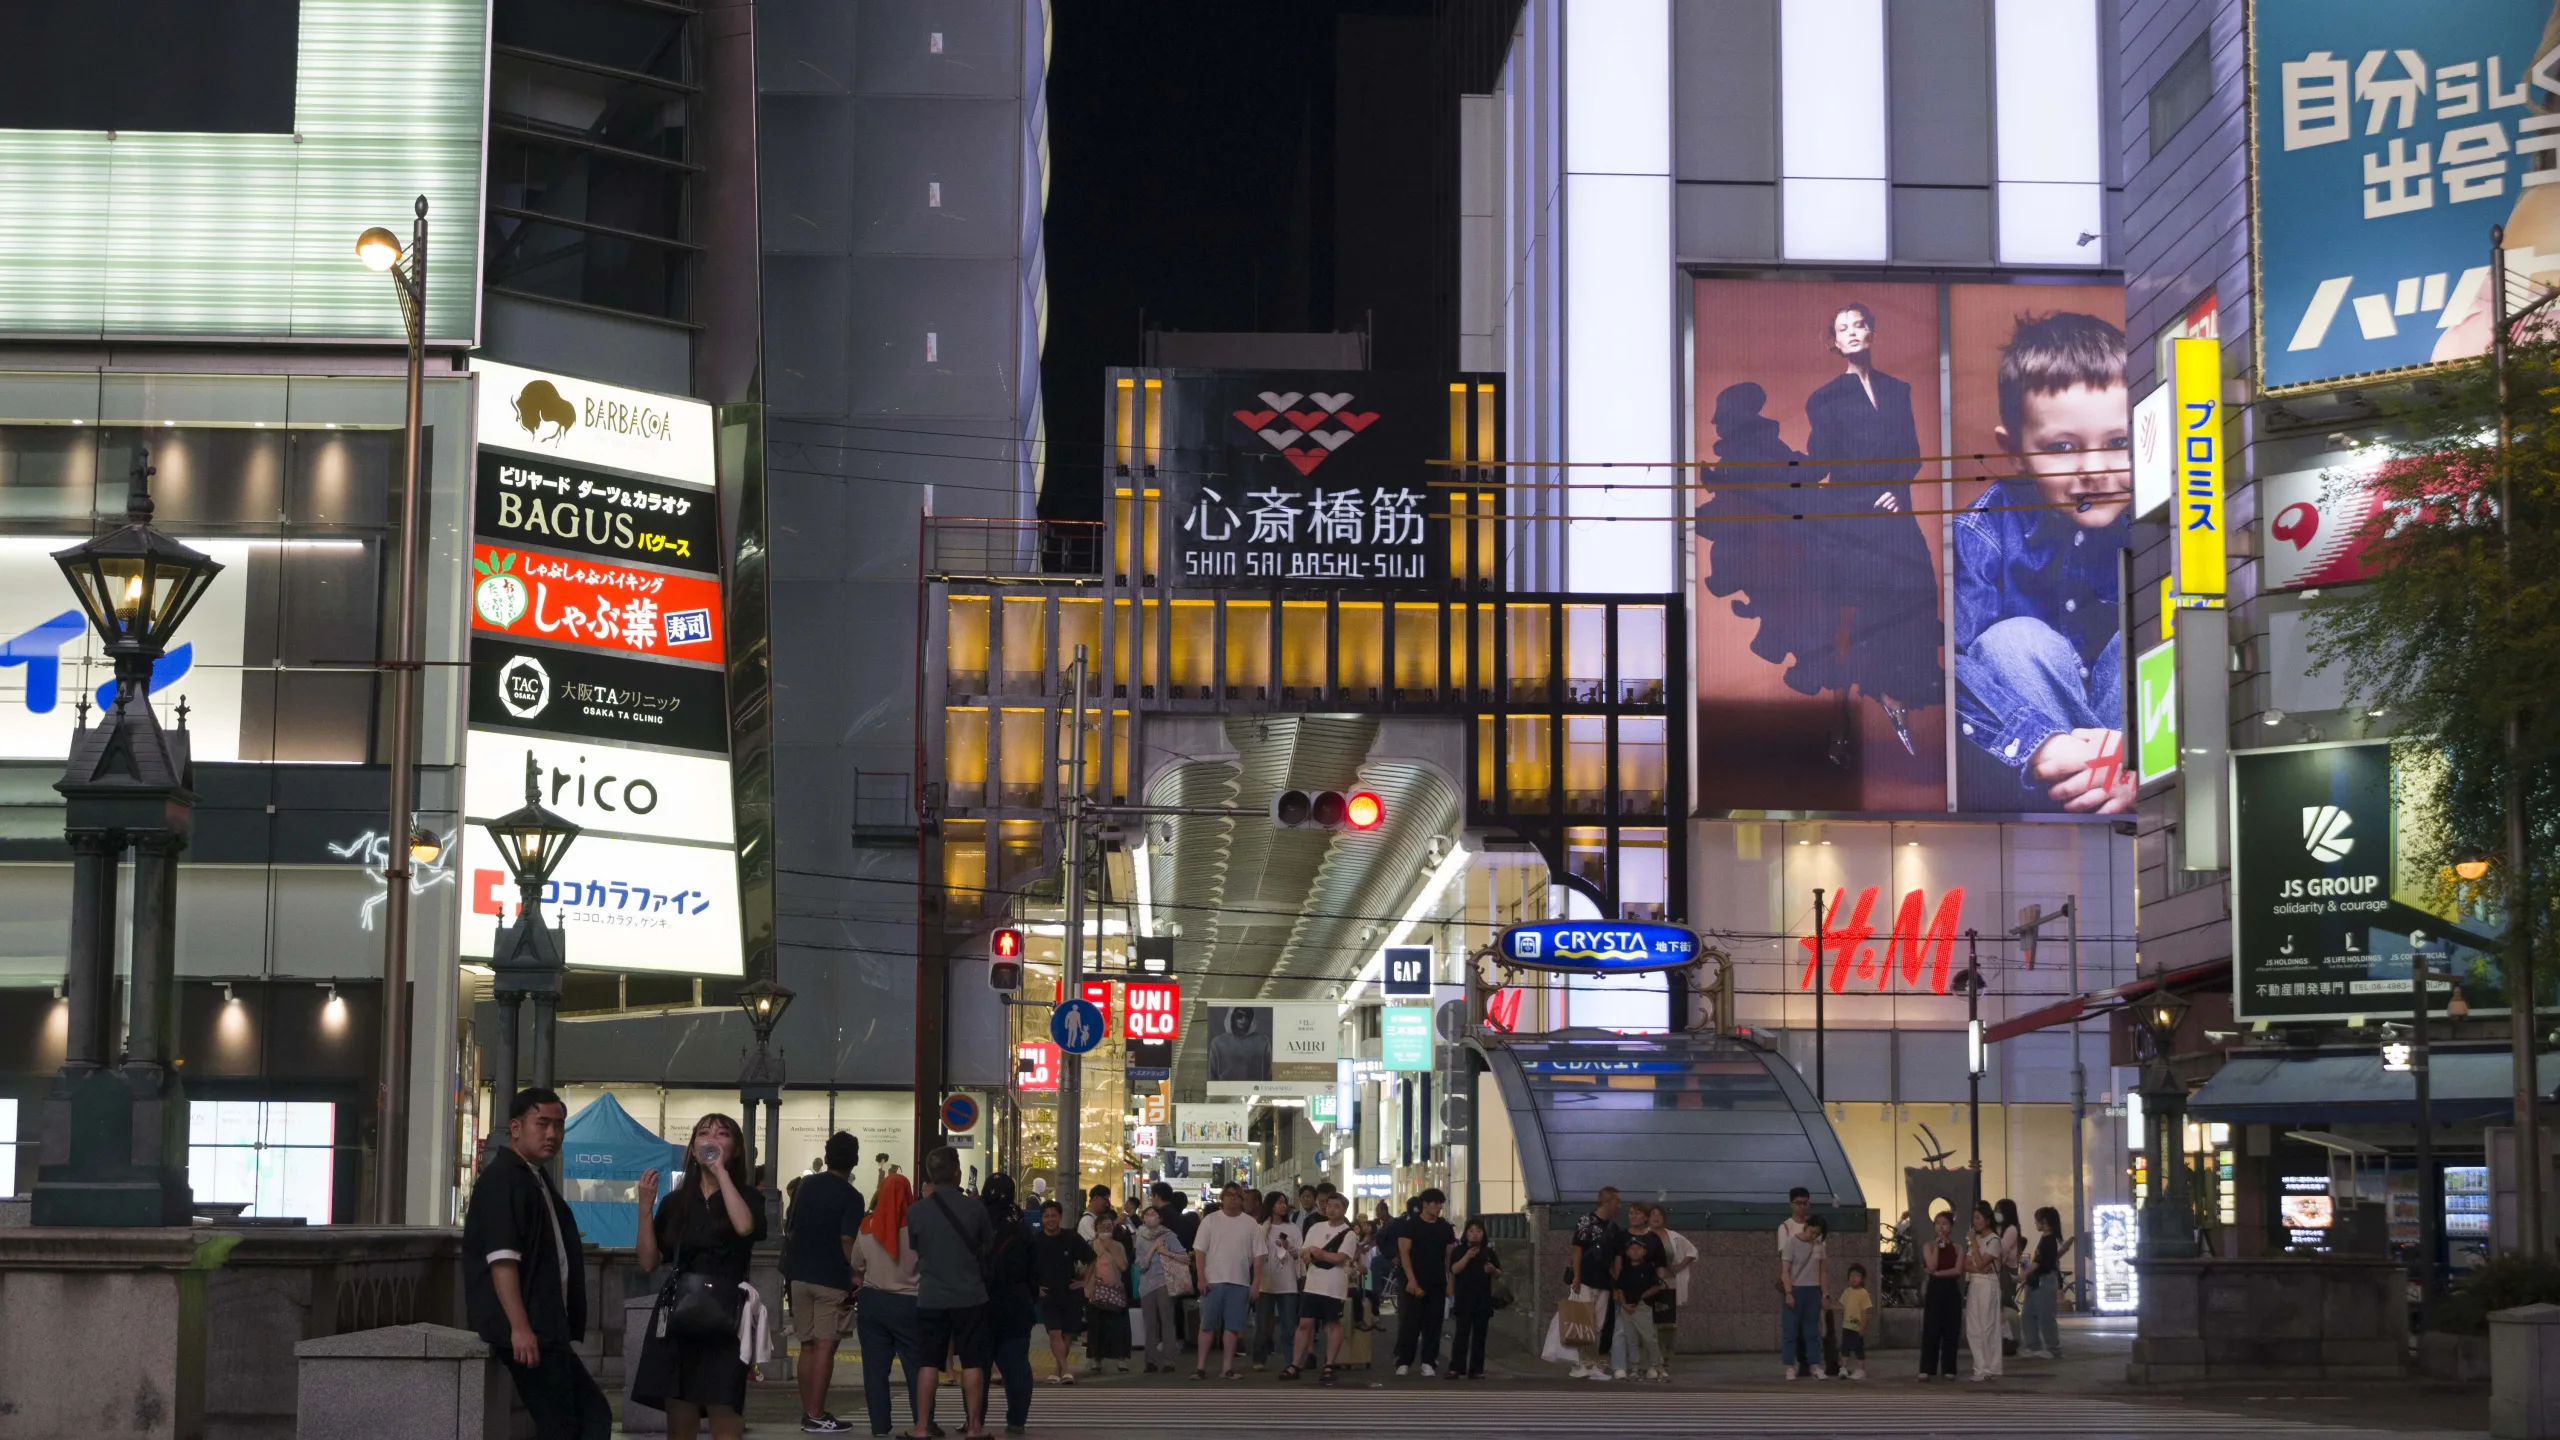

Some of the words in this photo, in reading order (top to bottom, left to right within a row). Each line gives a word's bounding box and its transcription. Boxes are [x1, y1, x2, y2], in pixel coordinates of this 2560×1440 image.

[585, 397, 671, 441] BARBACOA
[2184, 398, 2217, 532] プロミス
[500, 466, 571, 495] ビリヤード
[577, 480, 691, 516] ダーツ&カラオケ
[498, 491, 634, 549] BAGUS
[637, 532, 690, 557] バグース
[1183, 486, 1427, 546] 心斎橋筋
[525, 556, 665, 595] しゃぶしゃぶバイキング
[1185, 551, 1236, 576] SHIN
[1246, 552, 1282, 577] SAI
[1291, 552, 1425, 578] BASHI-SUJI
[534, 582, 659, 650] しゃぶ葉
[667, 612, 709, 641] 寿司
[511, 676, 539, 693] TAC
[514, 692, 536, 702] OSAKA
[560, 681, 681, 712] 大阪TAクリニック
[582, 705, 614, 718] OSAKA
[618, 710, 629, 720] TA
[633, 712, 664, 724] CLINIC
[541, 879, 710, 915] ココカラファイン
[2279, 878, 2304, 899] JS
[2307, 875, 2379, 896] GROUP
[2273, 902, 2324, 915] solidarity
[2327, 900, 2337, 912] &
[2340, 900, 2388, 912] courage
[1554, 930, 1646, 951] CRYSTA
[1655, 940, 1692, 953] 地下街
[1799, 886, 1965, 995] H&M
[2274, 957, 2309, 966] HOLDINGS
[2332, 955, 2346, 963] LIFE
[2347, 954, 2382, 963] HOLDINGS
[1393, 960, 1421, 981] GAP
[1130, 990, 1170, 1011] UNI
[2255, 981, 2344, 997] 不動産開発専門
[1129, 1013, 1174, 1036] QLO
[1286, 1041, 1325, 1052] AMIRI
[575, 1153, 613, 1164] IQOS
